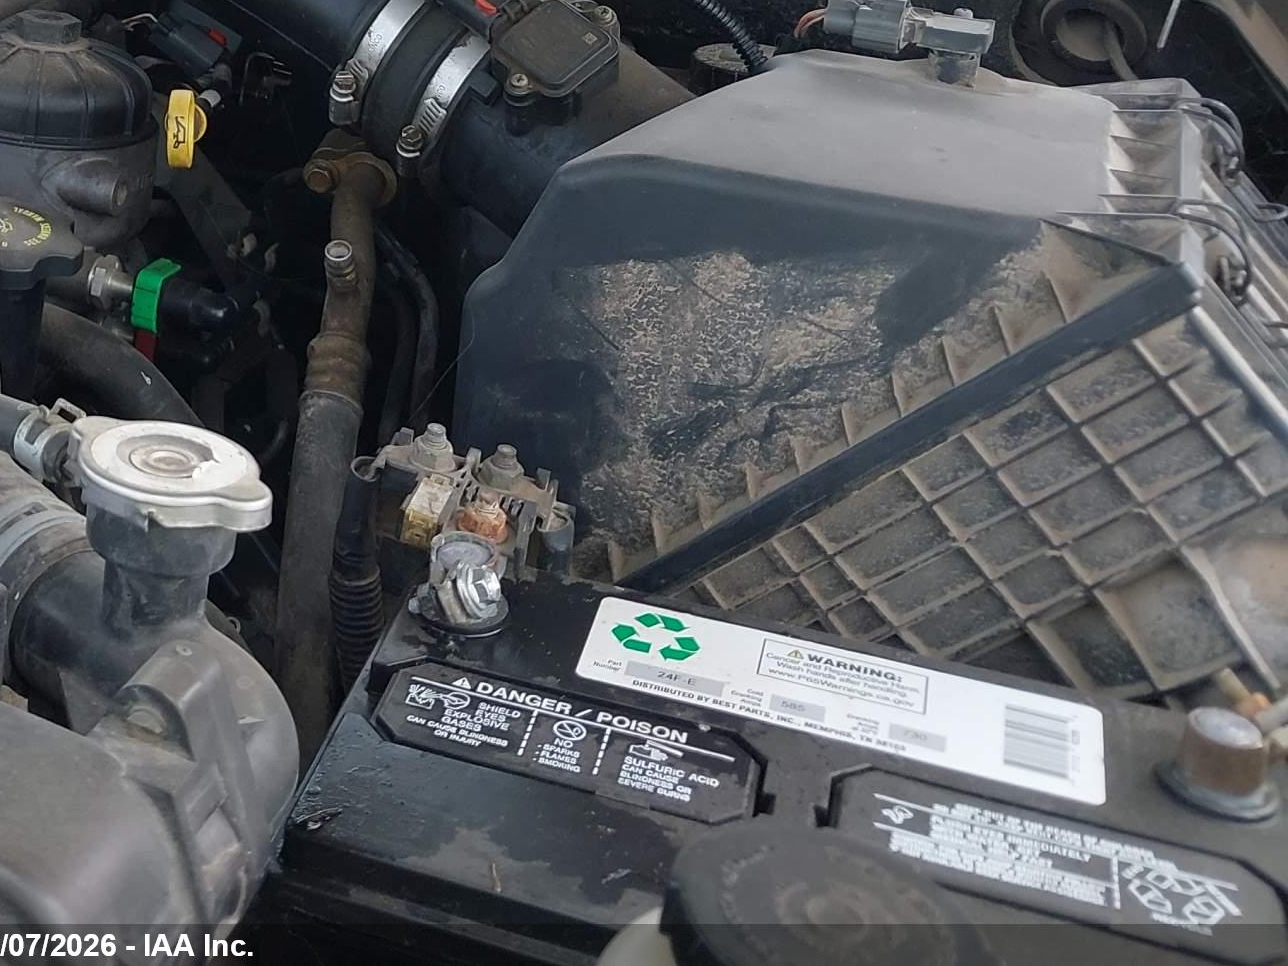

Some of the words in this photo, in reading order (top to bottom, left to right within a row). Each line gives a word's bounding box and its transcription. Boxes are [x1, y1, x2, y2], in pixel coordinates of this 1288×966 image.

[807, 653, 902, 682] WARNING:
[632, 679, 695, 699] DISTRIBUTED
[697, 695, 710, 704] BY
[712, 698, 737, 710] BEST
[475, 709, 507, 722] EYES
[476, 681, 573, 716] DANGER
[596, 711, 689, 744] POISON
[478, 701, 521, 718] SHIELD
[406, 715, 427, 725] CAN
[441, 715, 483, 732] GASES
[443, 708, 511, 731] EXPLOSIVE
[553, 737, 574, 749] NO
[539, 750, 578, 765] FLAMES
[621, 764, 644, 775] CAN
[645, 770, 680, 784] CAUSE
[624, 755, 686, 778] SULFURIC
[688, 773, 721, 788] ACID
